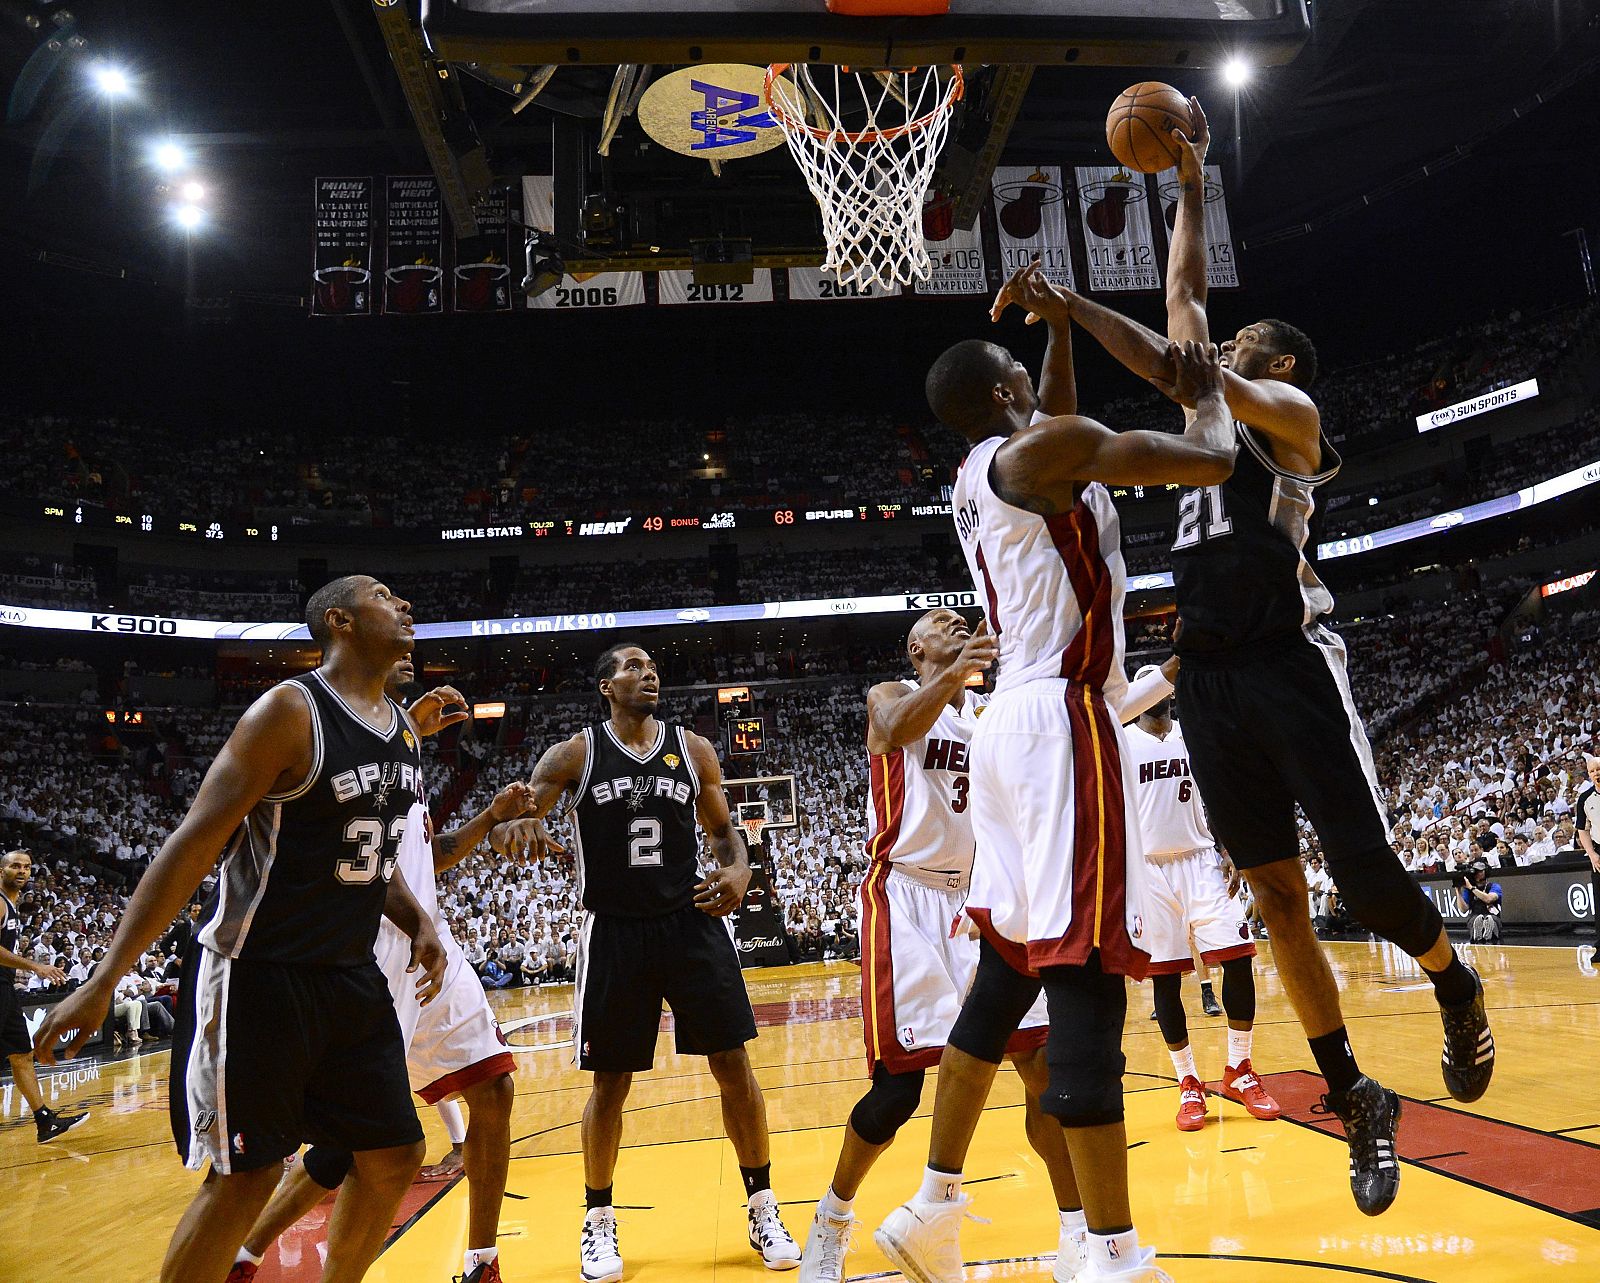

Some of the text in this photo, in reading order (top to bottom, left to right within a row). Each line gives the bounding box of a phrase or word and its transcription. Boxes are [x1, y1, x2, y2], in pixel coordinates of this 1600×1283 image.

[322, 182, 363, 190] MIAMI
[392, 181, 433, 189] MIAMI
[330, 190, 366, 199] HEAT
[400, 189, 435, 198] HEAT
[390, 201, 439, 209] SOUTHEAST
[318, 211, 369, 219] DIVISION
[390, 210, 439, 218] DIVISION
[317, 220, 369, 228] CHAMPIONS
[389, 219, 440, 227] CHAMPIONS
[1006, 248, 1067, 268] 10 11
[1091, 246, 1151, 267] 11 12
[1208, 244, 1231, 263] 13
[955, 250, 981, 270] 06
[918, 280, 983, 290] CHAMPIONS
[1093, 277, 1157, 287] CHAMPIONS
[555, 287, 617, 307] 2006
[687, 283, 744, 302] 2012
[1435, 389, 1517, 421] FOX SUN SPORTS
[1587, 467, 1600, 479] KI
[44, 507, 64, 516] 3PM
[75, 507, 82, 515] 4
[805, 509, 854, 520] SPURS
[912, 505, 953, 516] HUSTLE
[115, 515, 132, 524] 3PA
[141, 515, 153, 523] 10
[710, 512, 735, 523] 4:25
[774, 510, 794, 525] 68
[860, 512, 866, 520] 5
[1170, 483, 1234, 552] 21
[179, 523, 197, 532] 3P%
[209, 523, 221, 531] 40
[579, 517, 632, 536] HEAT
[642, 516, 663, 531] 49
[670, 518, 699, 527] BONUS
[205, 530, 224, 539] 37.5
[246, 528, 258, 536] TO
[441, 526, 523, 540] HUSTLE STATS
[535, 528, 548, 536] 3/1
[566, 527, 573, 535] 2
[1321, 535, 1374, 559] K900
[975, 540, 1003, 637] 1
[835, 603, 853, 611] KIA
[471, 612, 617, 636] kia.com/K900
[737, 722, 760, 732] 4:24
[1139, 758, 1190, 785] HEAT
[591, 775, 692, 812] SPURS
[951, 776, 970, 814] 3
[1178, 779, 1193, 803] 6
[627, 816, 664, 869] 2
[752, 936, 783, 951] Finals
